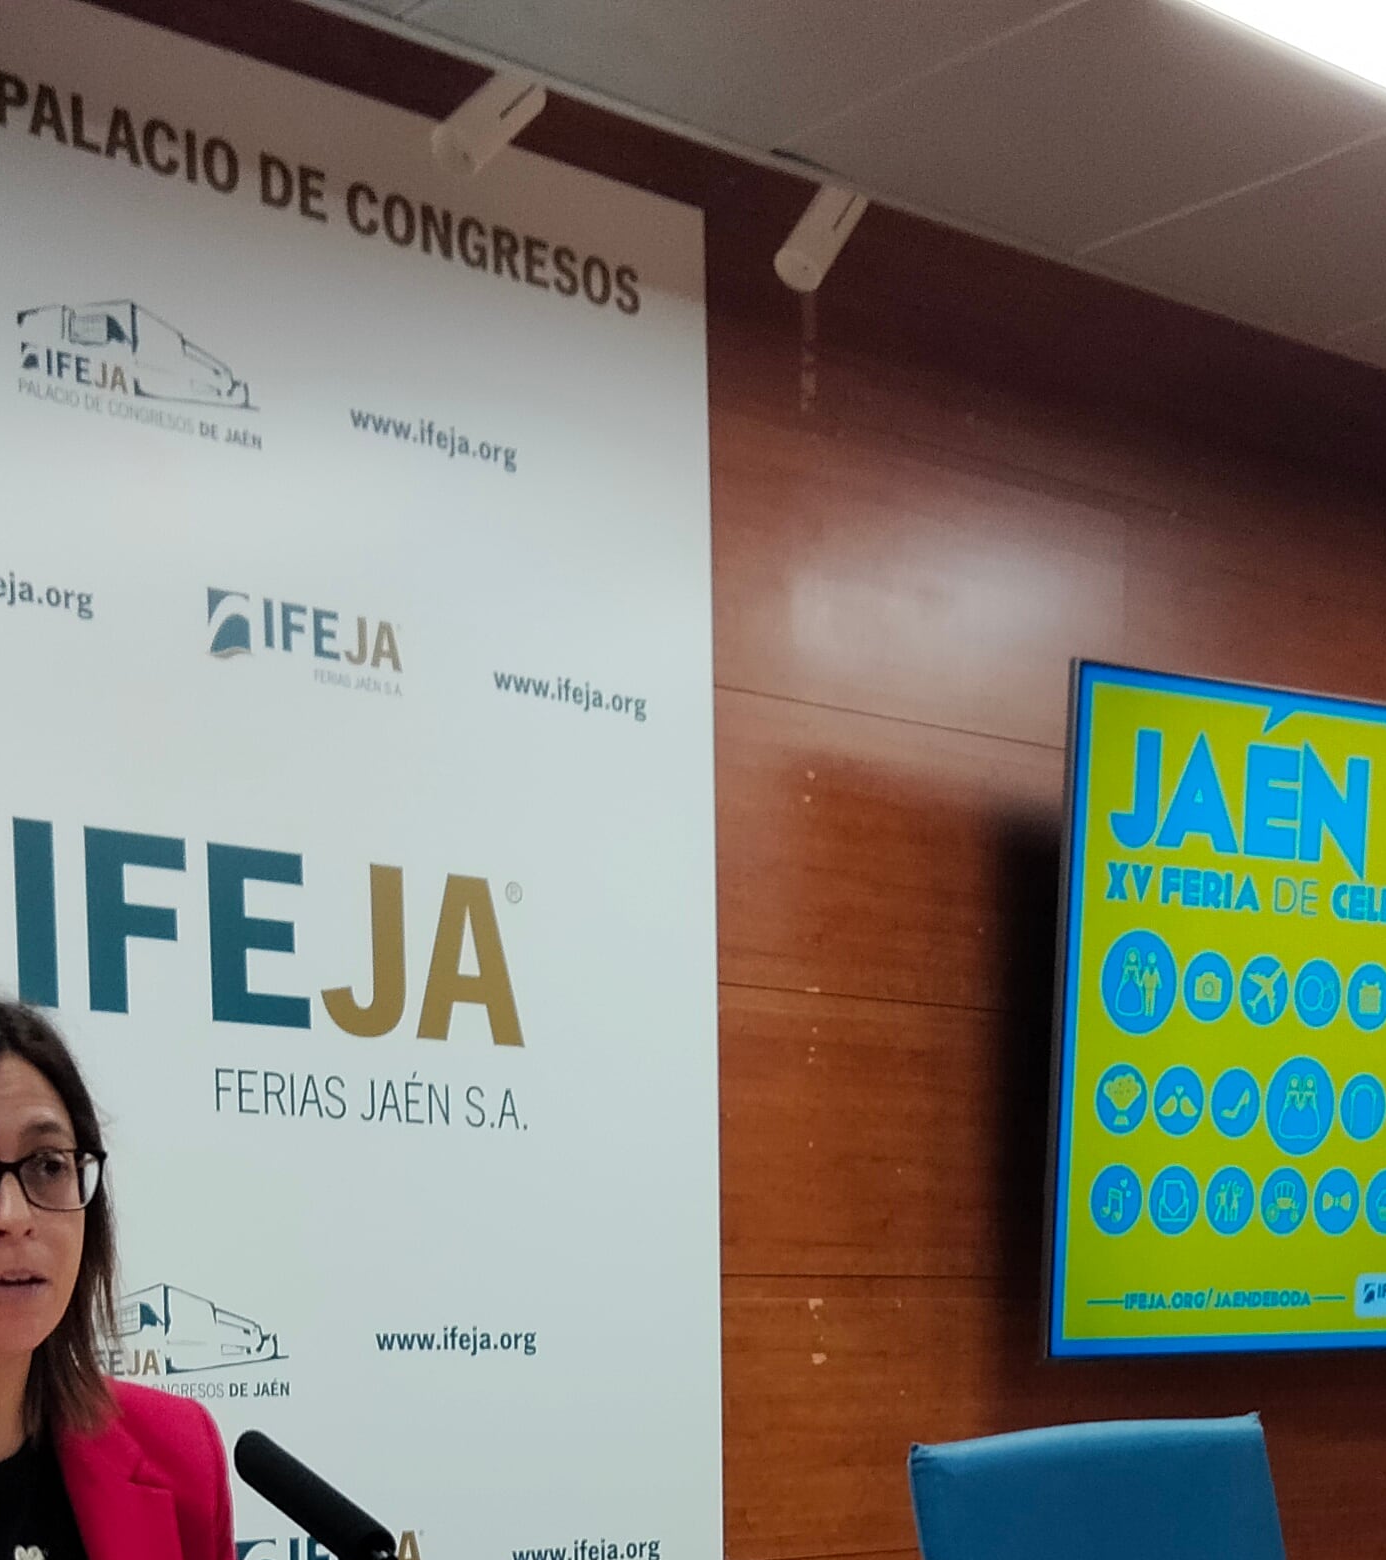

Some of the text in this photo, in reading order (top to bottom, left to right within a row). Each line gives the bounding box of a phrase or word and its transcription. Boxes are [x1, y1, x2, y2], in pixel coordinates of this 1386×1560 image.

[259, 152, 328, 222] DE
[345, 182, 641, 314] CONGRESOS
[46, 348, 128, 395] IFEJA
[199, 419, 219, 441] DE
[350, 408, 518, 472] www.ifeja.org
[263, 596, 402, 673] IFEJA
[493, 668, 648, 722] www.ifeja.org
[1109, 707, 1371, 880] JAÉN
[1105, 861, 1154, 903] XV
[1160, 865, 1261, 913] FERIA
[1273, 876, 1319, 916] DE
[12, 815, 525, 1048] IFEJA
[214, 1067, 529, 1132] FERIAS JAÉN S.A.
[1123, 1287, 1312, 1311] IFEJA.ORG/JAENDEBODA
[376, 1326, 538, 1356] www.ifeja.org
[228, 1382, 249, 1399] DE
[253, 1378, 290, 1398] JAÉN
